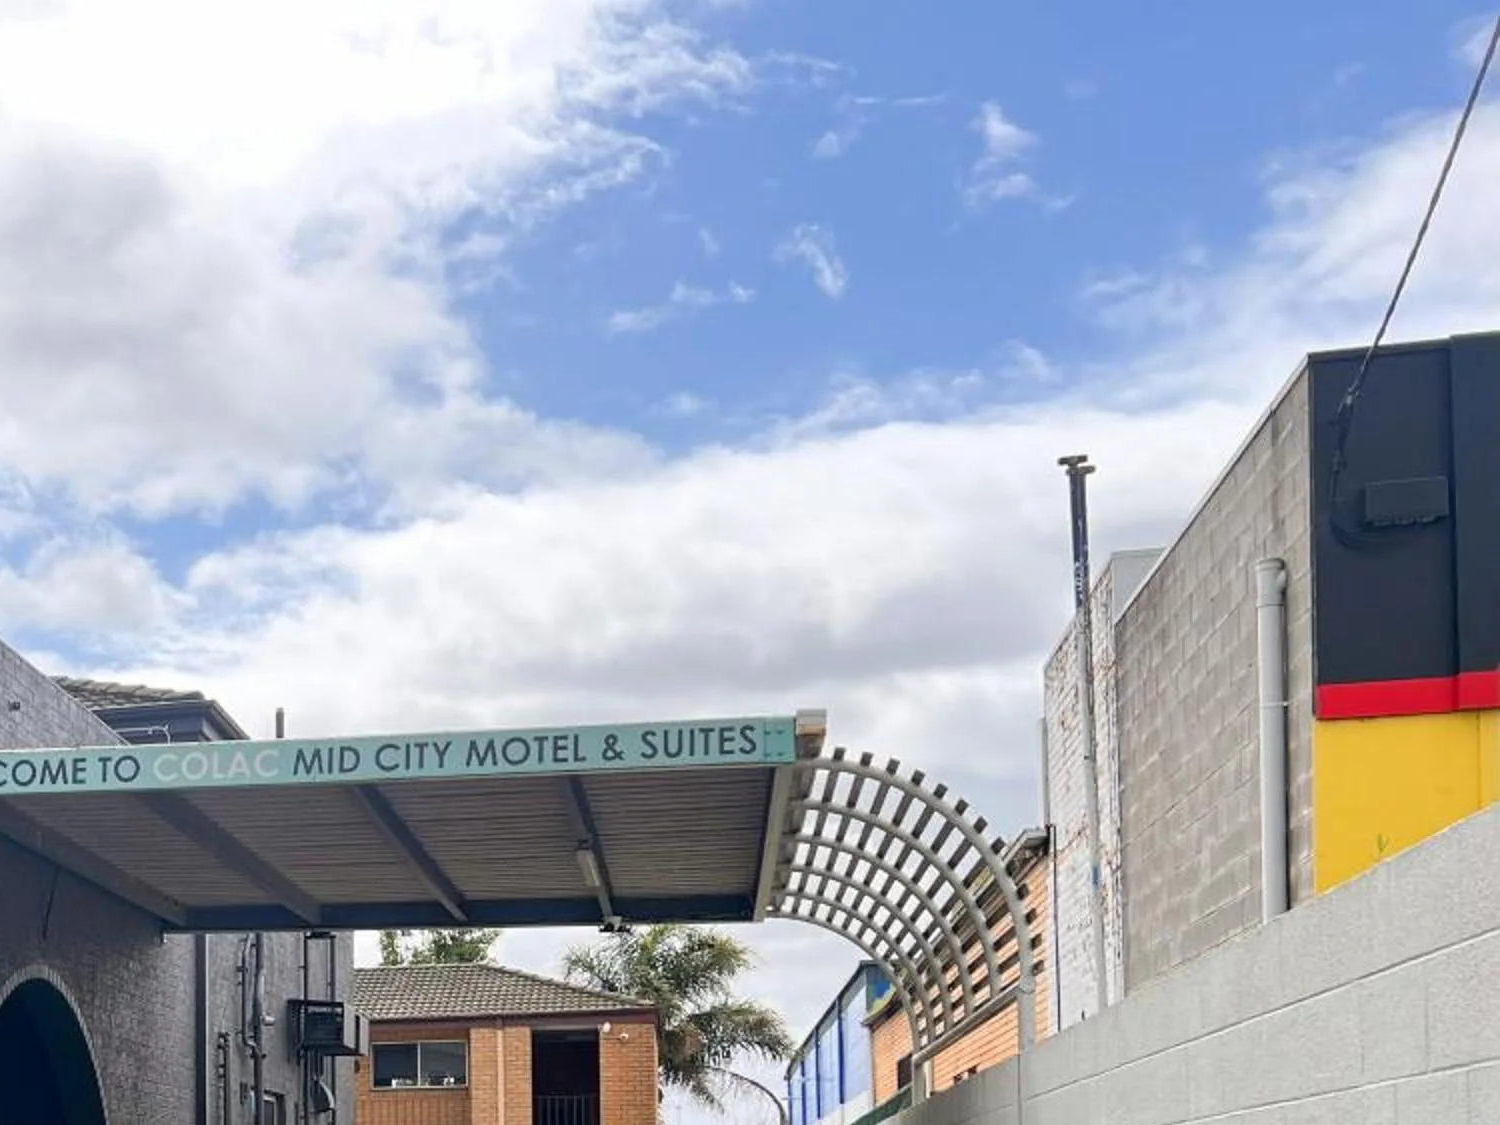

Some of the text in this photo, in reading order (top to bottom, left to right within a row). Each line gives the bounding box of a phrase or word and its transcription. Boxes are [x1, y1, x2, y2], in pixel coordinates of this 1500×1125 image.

[98, 755, 141, 783] TO
[153, 749, 280, 780] COLAC
[293, 746, 360, 775] MID
[375, 741, 453, 772] CITY
[465, 734, 587, 767] MOTEL
[601, 734, 625, 760] &
[640, 724, 757, 758] SUITES
